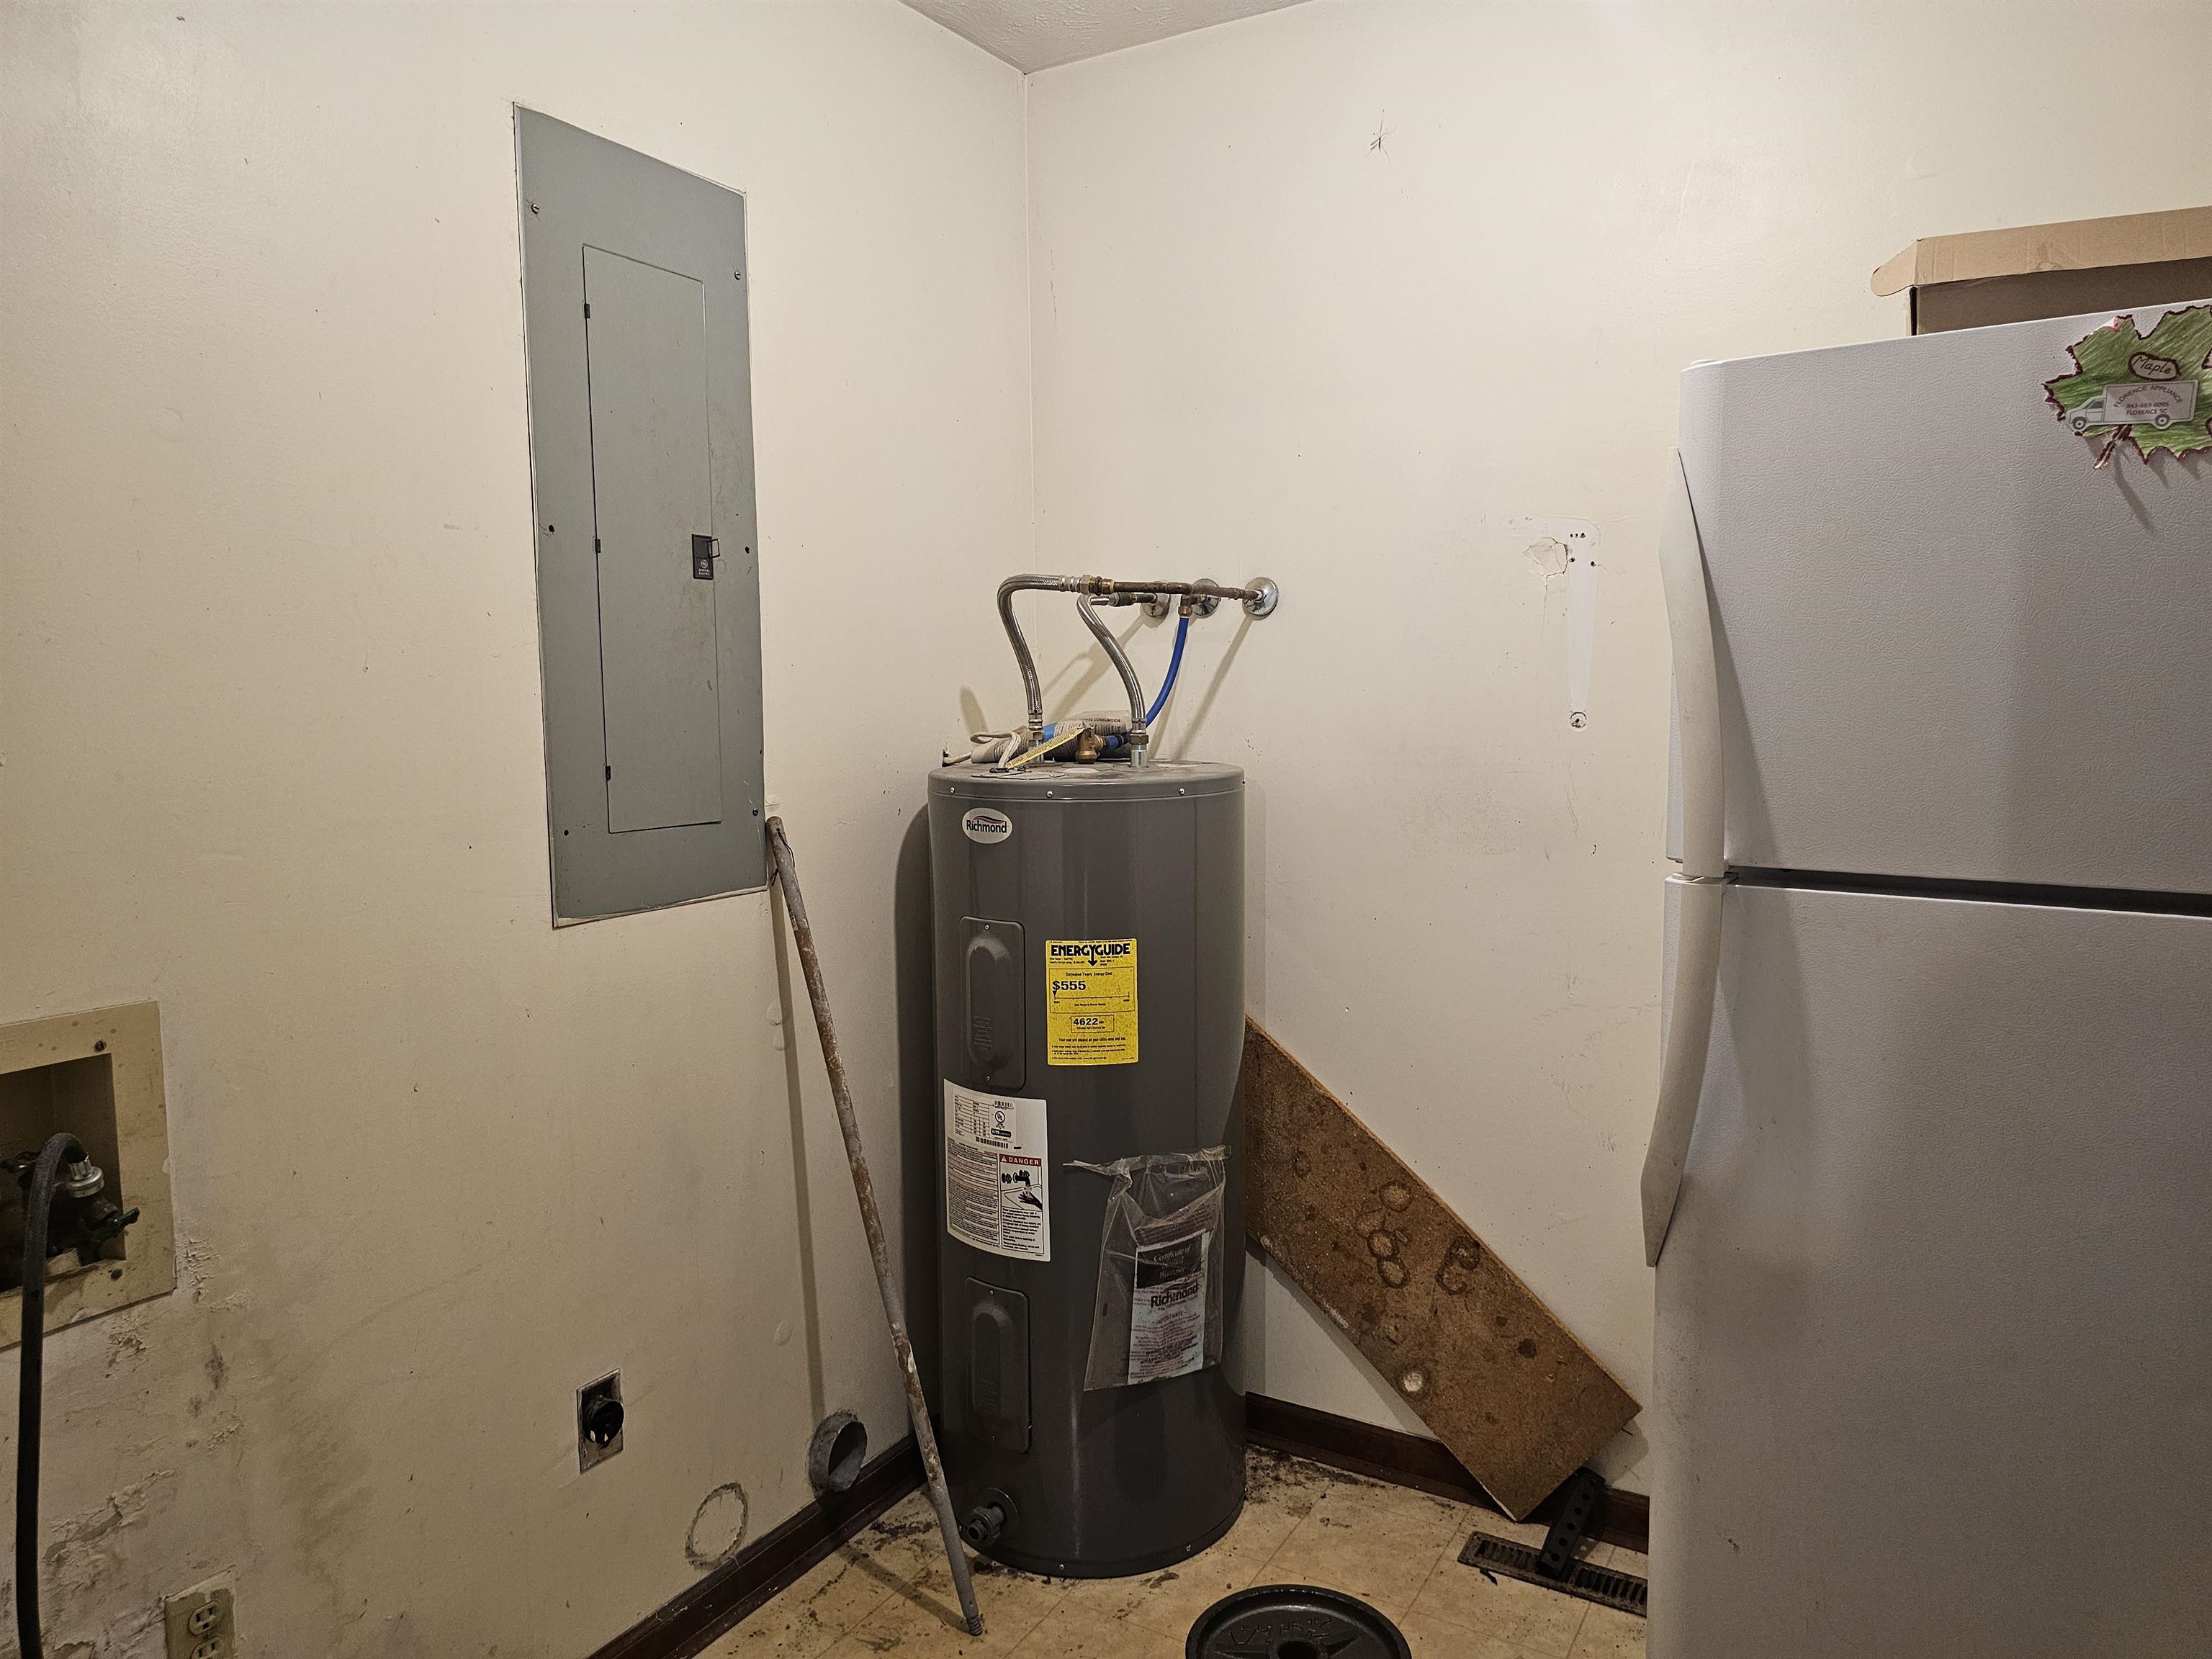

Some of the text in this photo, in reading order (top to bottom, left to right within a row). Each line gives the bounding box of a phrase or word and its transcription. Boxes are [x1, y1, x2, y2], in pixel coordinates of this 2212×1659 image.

[2132, 356, 2172, 375] Maple
[2113, 385, 2183, 408] FLORENCE APPLIANCE
[966, 819, 1007, 833] Richmond
[1051, 943, 1130, 957] ENERGYGUIDE
[1052, 980, 1087, 991] $555
[1009, 1156, 1039, 1165] DANGER
[1151, 1280, 1200, 1308] Richmond
